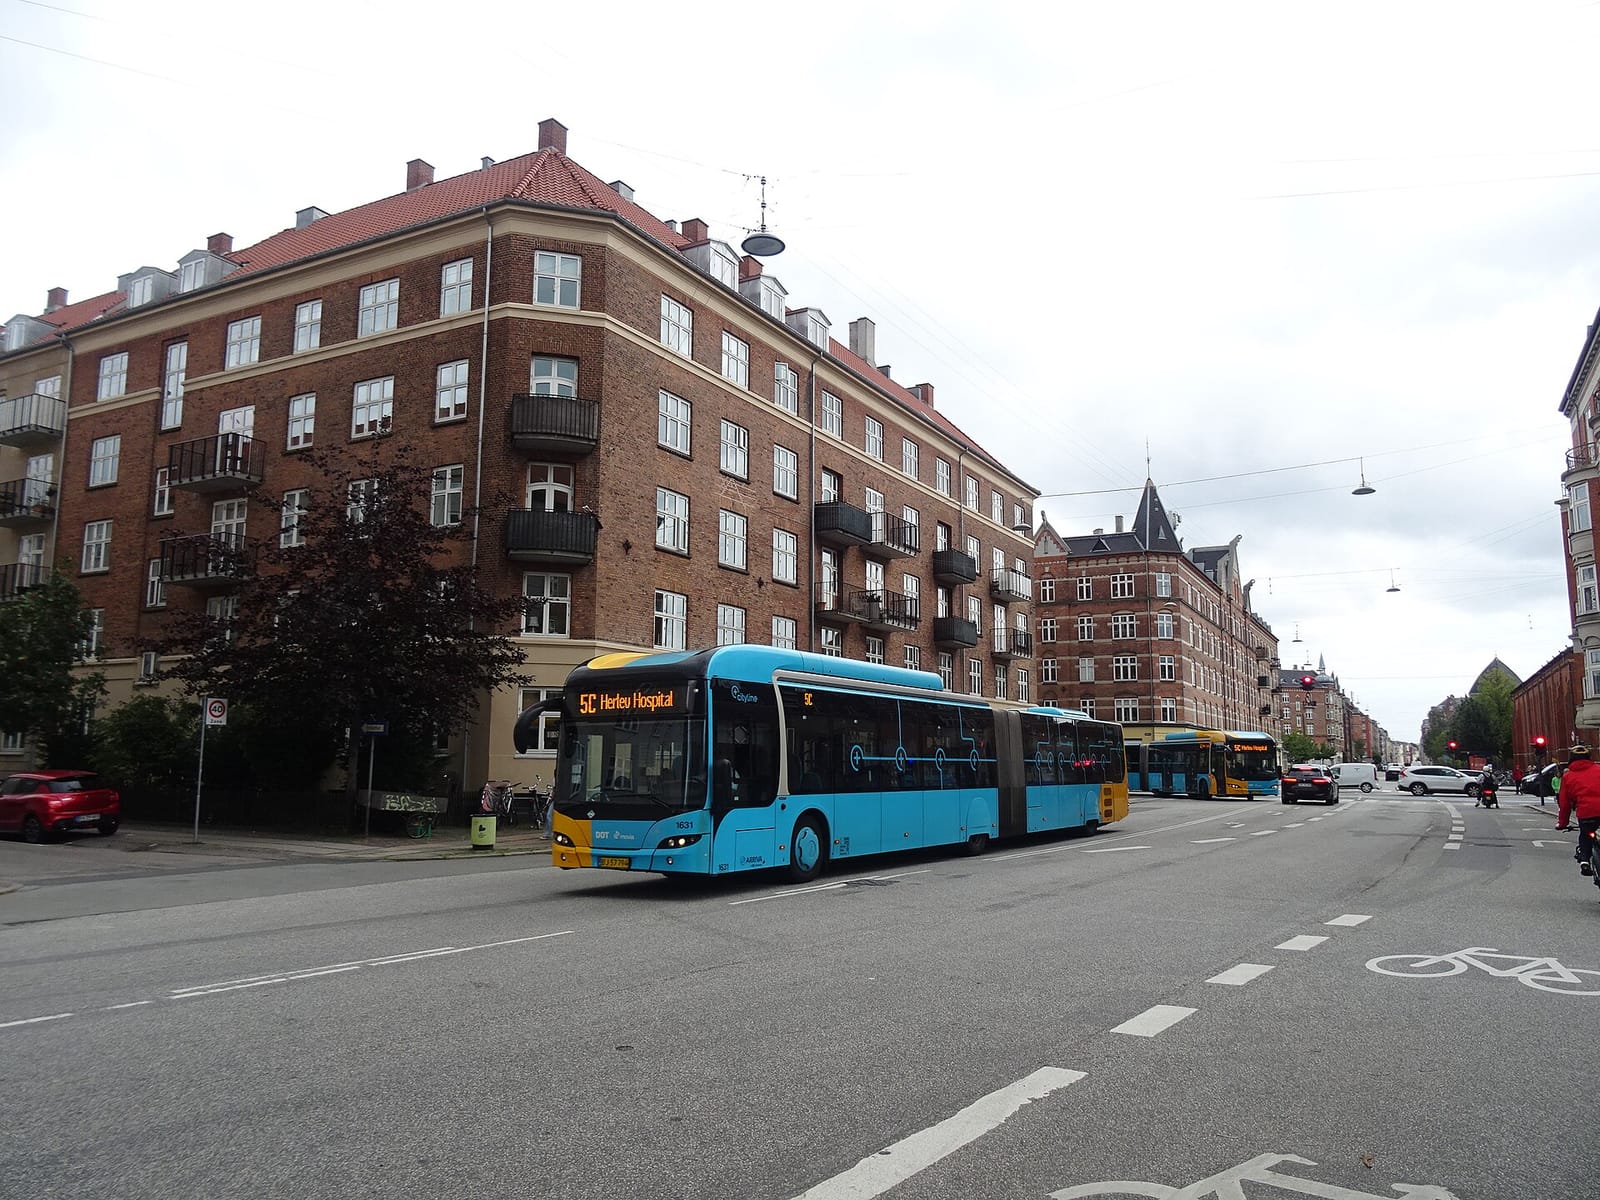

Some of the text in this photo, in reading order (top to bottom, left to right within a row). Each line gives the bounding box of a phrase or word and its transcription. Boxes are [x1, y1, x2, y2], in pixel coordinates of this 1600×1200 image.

[580, 690, 674, 714] 5C Herlev Hospital
[804, 692, 813, 706] 5C
[676, 821, 694, 829] 1631
